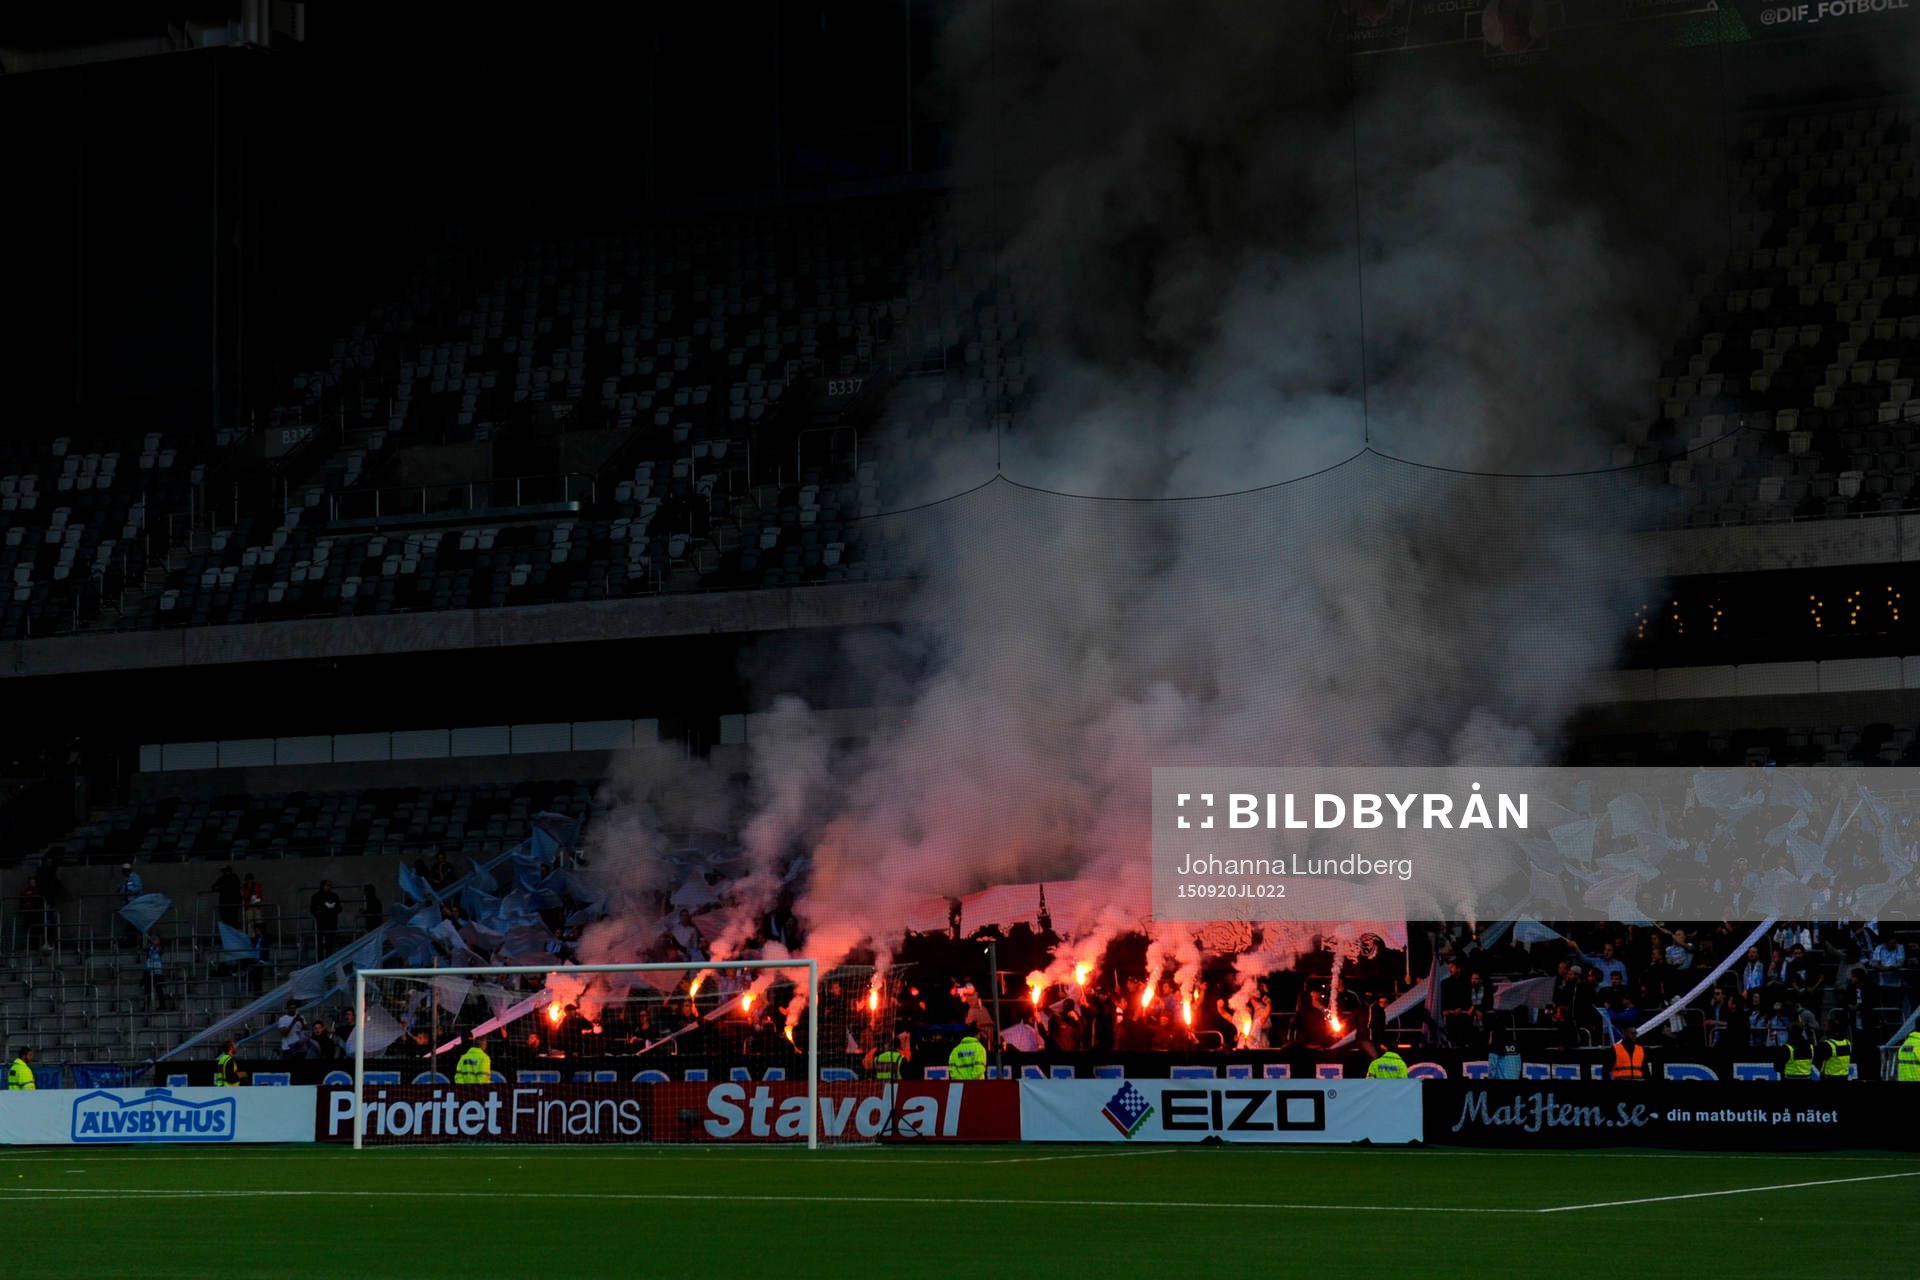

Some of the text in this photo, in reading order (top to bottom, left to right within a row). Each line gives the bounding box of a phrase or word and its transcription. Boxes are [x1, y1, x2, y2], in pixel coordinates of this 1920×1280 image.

[80, 1109, 226, 1133] ÄLVSBYHUS
[328, 1088, 642, 1136] Prioritet Finans
[703, 1082, 965, 1138] Stavdal
[1161, 1090, 1326, 1131] EIZO
[1666, 1108, 1691, 1122] din
[1695, 1108, 1768, 1122] matbutik
[1771, 1107, 1792, 1125] på
[1796, 1108, 1839, 1123] nätet
